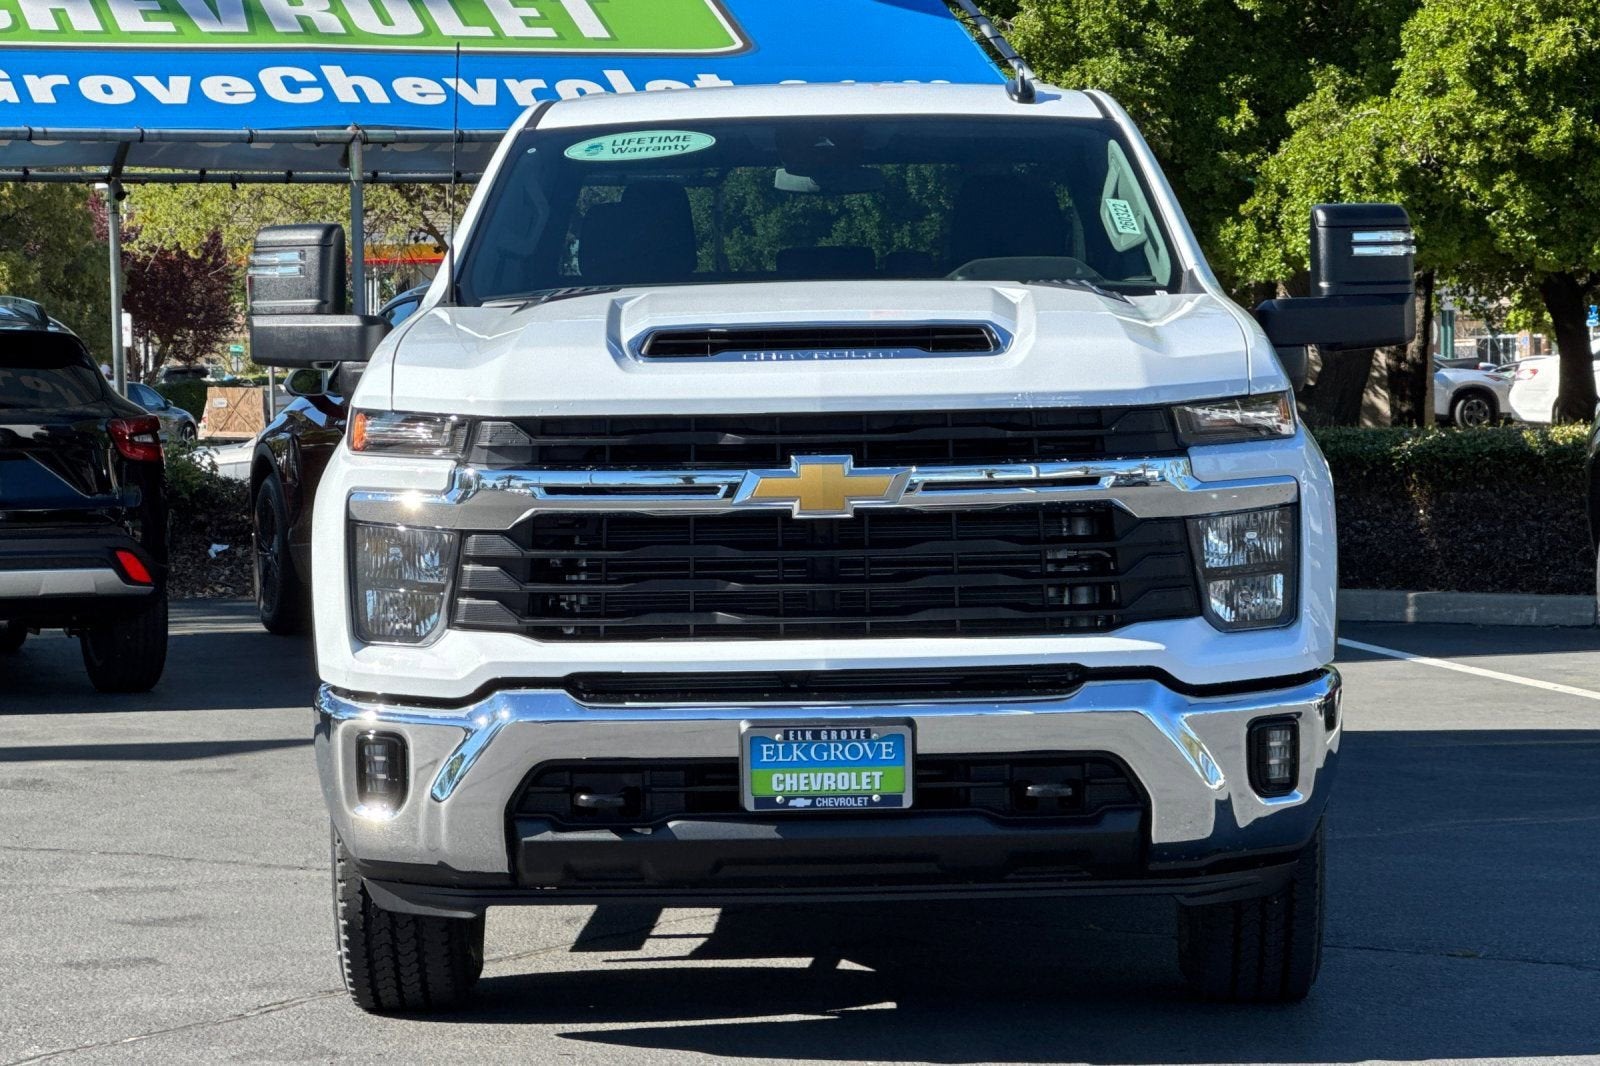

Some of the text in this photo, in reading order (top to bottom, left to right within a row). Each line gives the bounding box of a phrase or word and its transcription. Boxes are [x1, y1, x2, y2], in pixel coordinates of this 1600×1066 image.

[0, 0, 611, 38] HEVROLET
[612, 135, 692, 147] LIFETIME
[611, 143, 690, 155] Warranty
[789, 729, 866, 741] ELK GROVE
[771, 771, 883, 792] CHEVROLET
[815, 797, 869, 807] CHEVROLET
